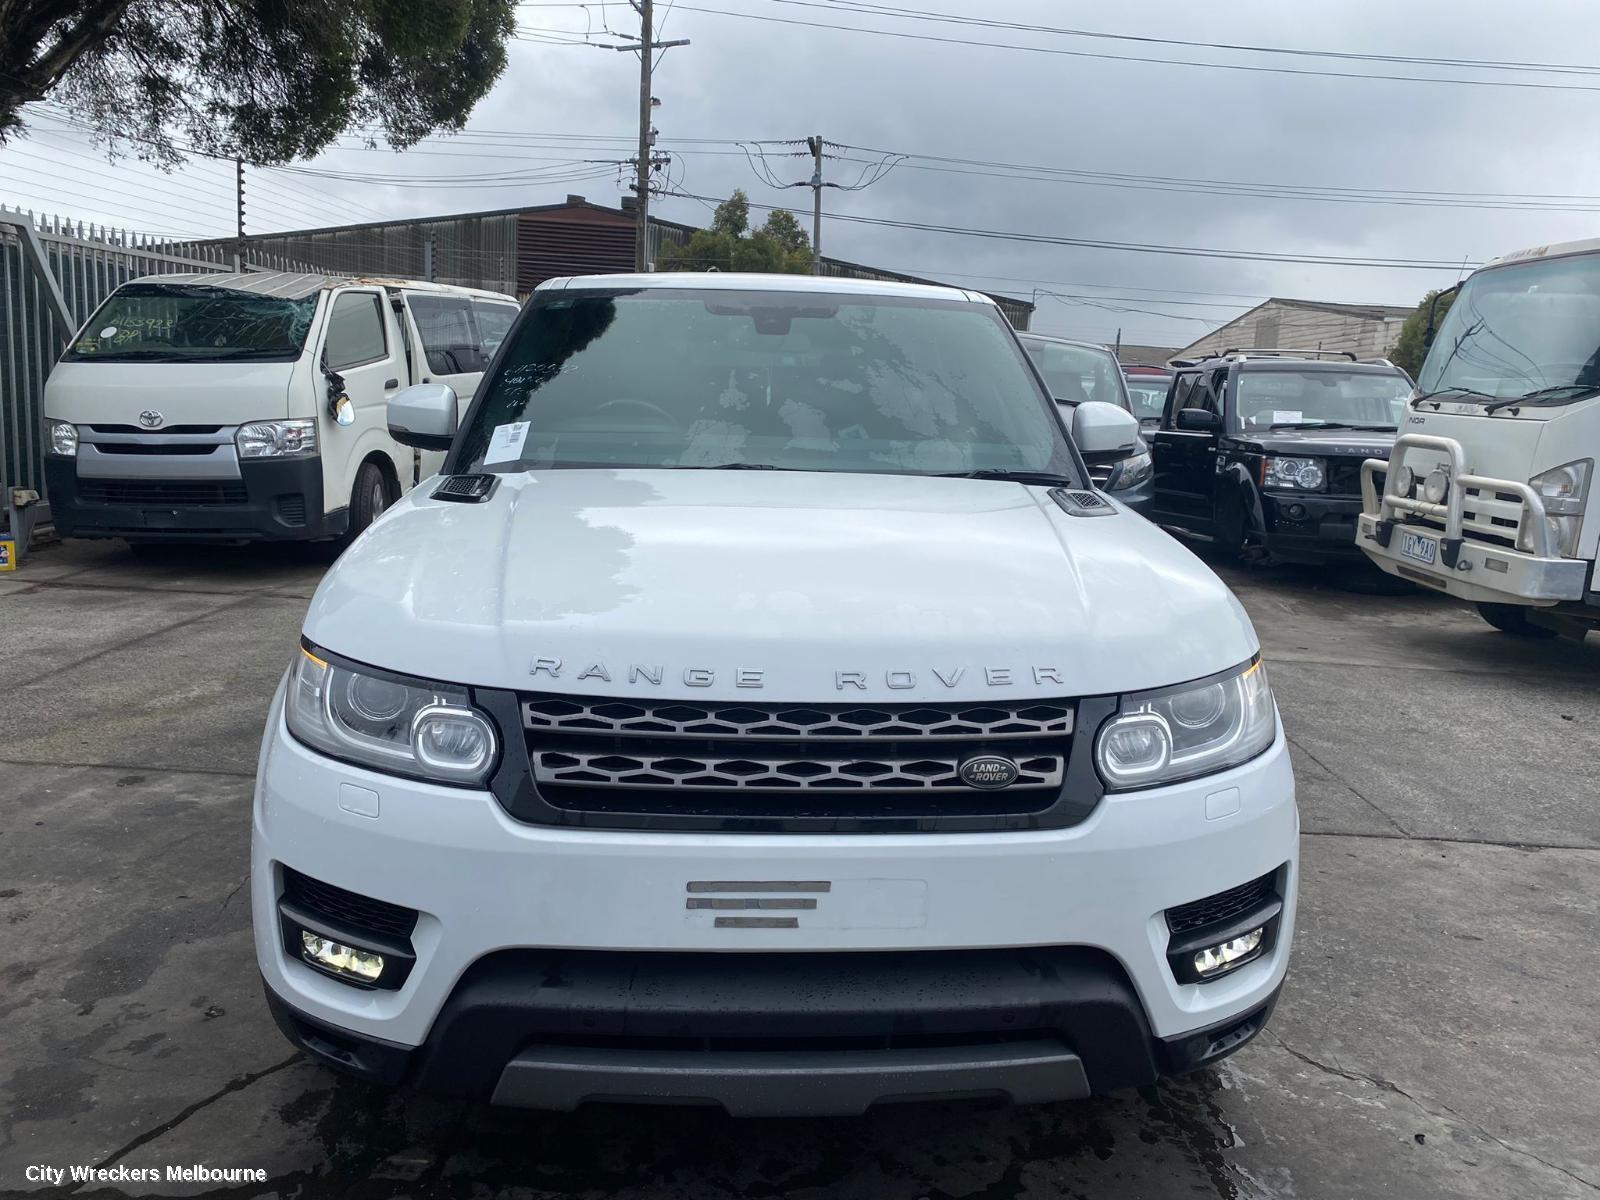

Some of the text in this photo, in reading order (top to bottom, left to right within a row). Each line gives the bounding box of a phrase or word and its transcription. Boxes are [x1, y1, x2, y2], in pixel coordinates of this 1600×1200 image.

[1334, 447, 1383, 455] LAND
[529, 655, 1064, 689] RANGE ROVER
[973, 763, 1000, 773] LAND
[975, 772, 1009, 781] ROVER
